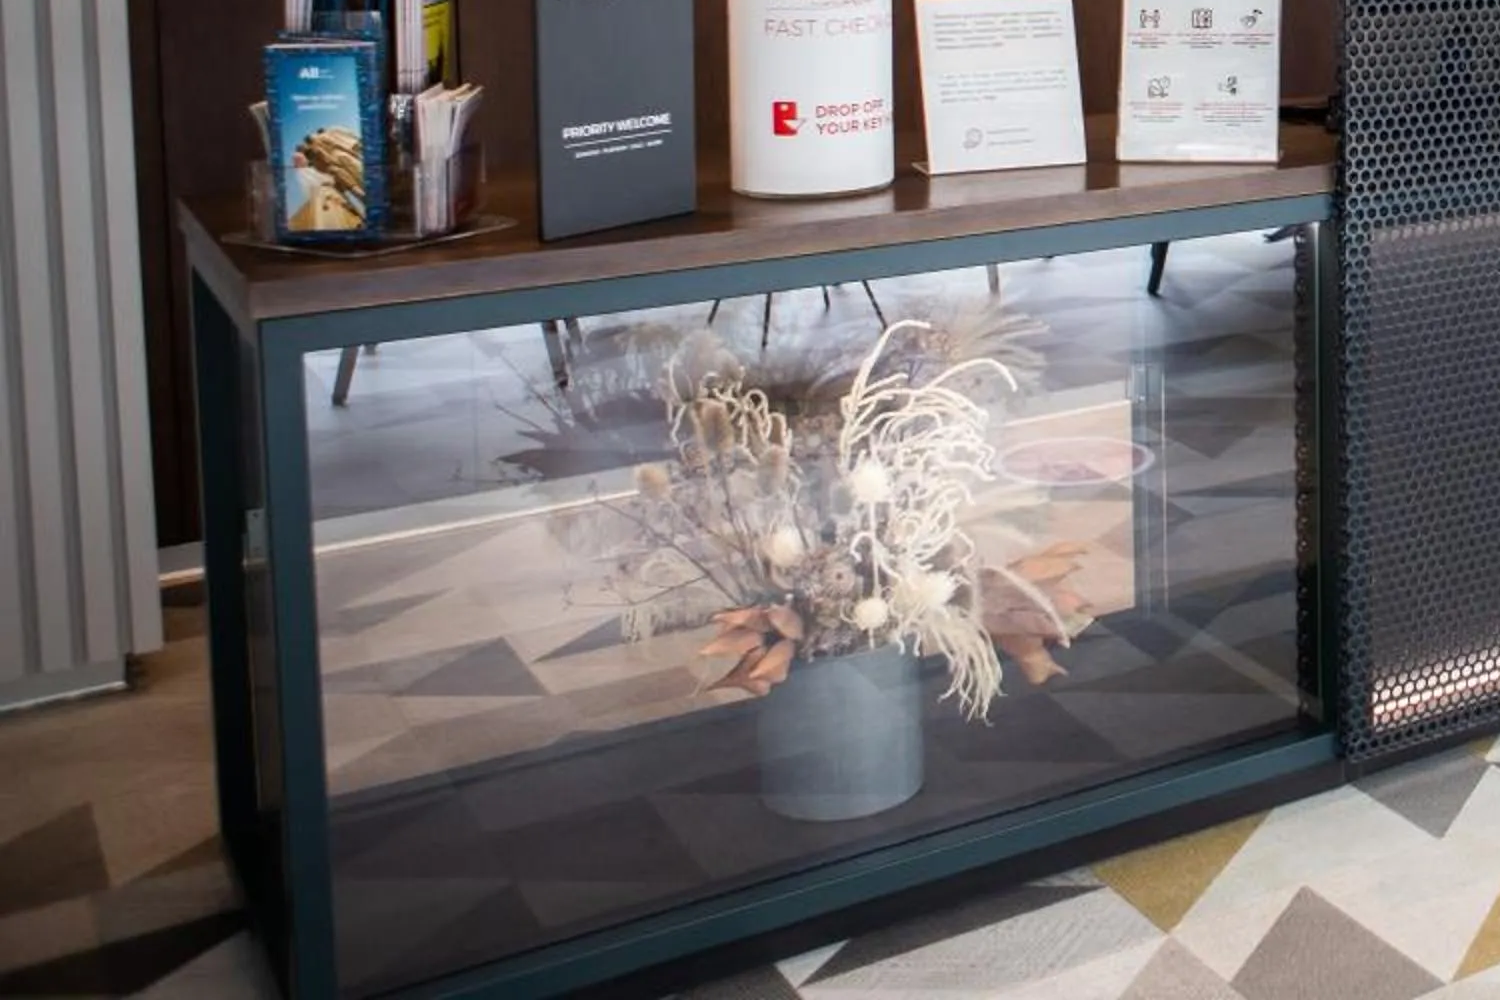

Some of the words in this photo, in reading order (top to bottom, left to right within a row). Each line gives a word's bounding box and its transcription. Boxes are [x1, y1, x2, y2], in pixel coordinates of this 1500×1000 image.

[764, 18, 817, 37] FAST
[815, 102, 860, 119] DROP
[562, 121, 615, 139] PRIORITY
[616, 112, 671, 131] WELCOME
[815, 119, 859, 135] YOUR
